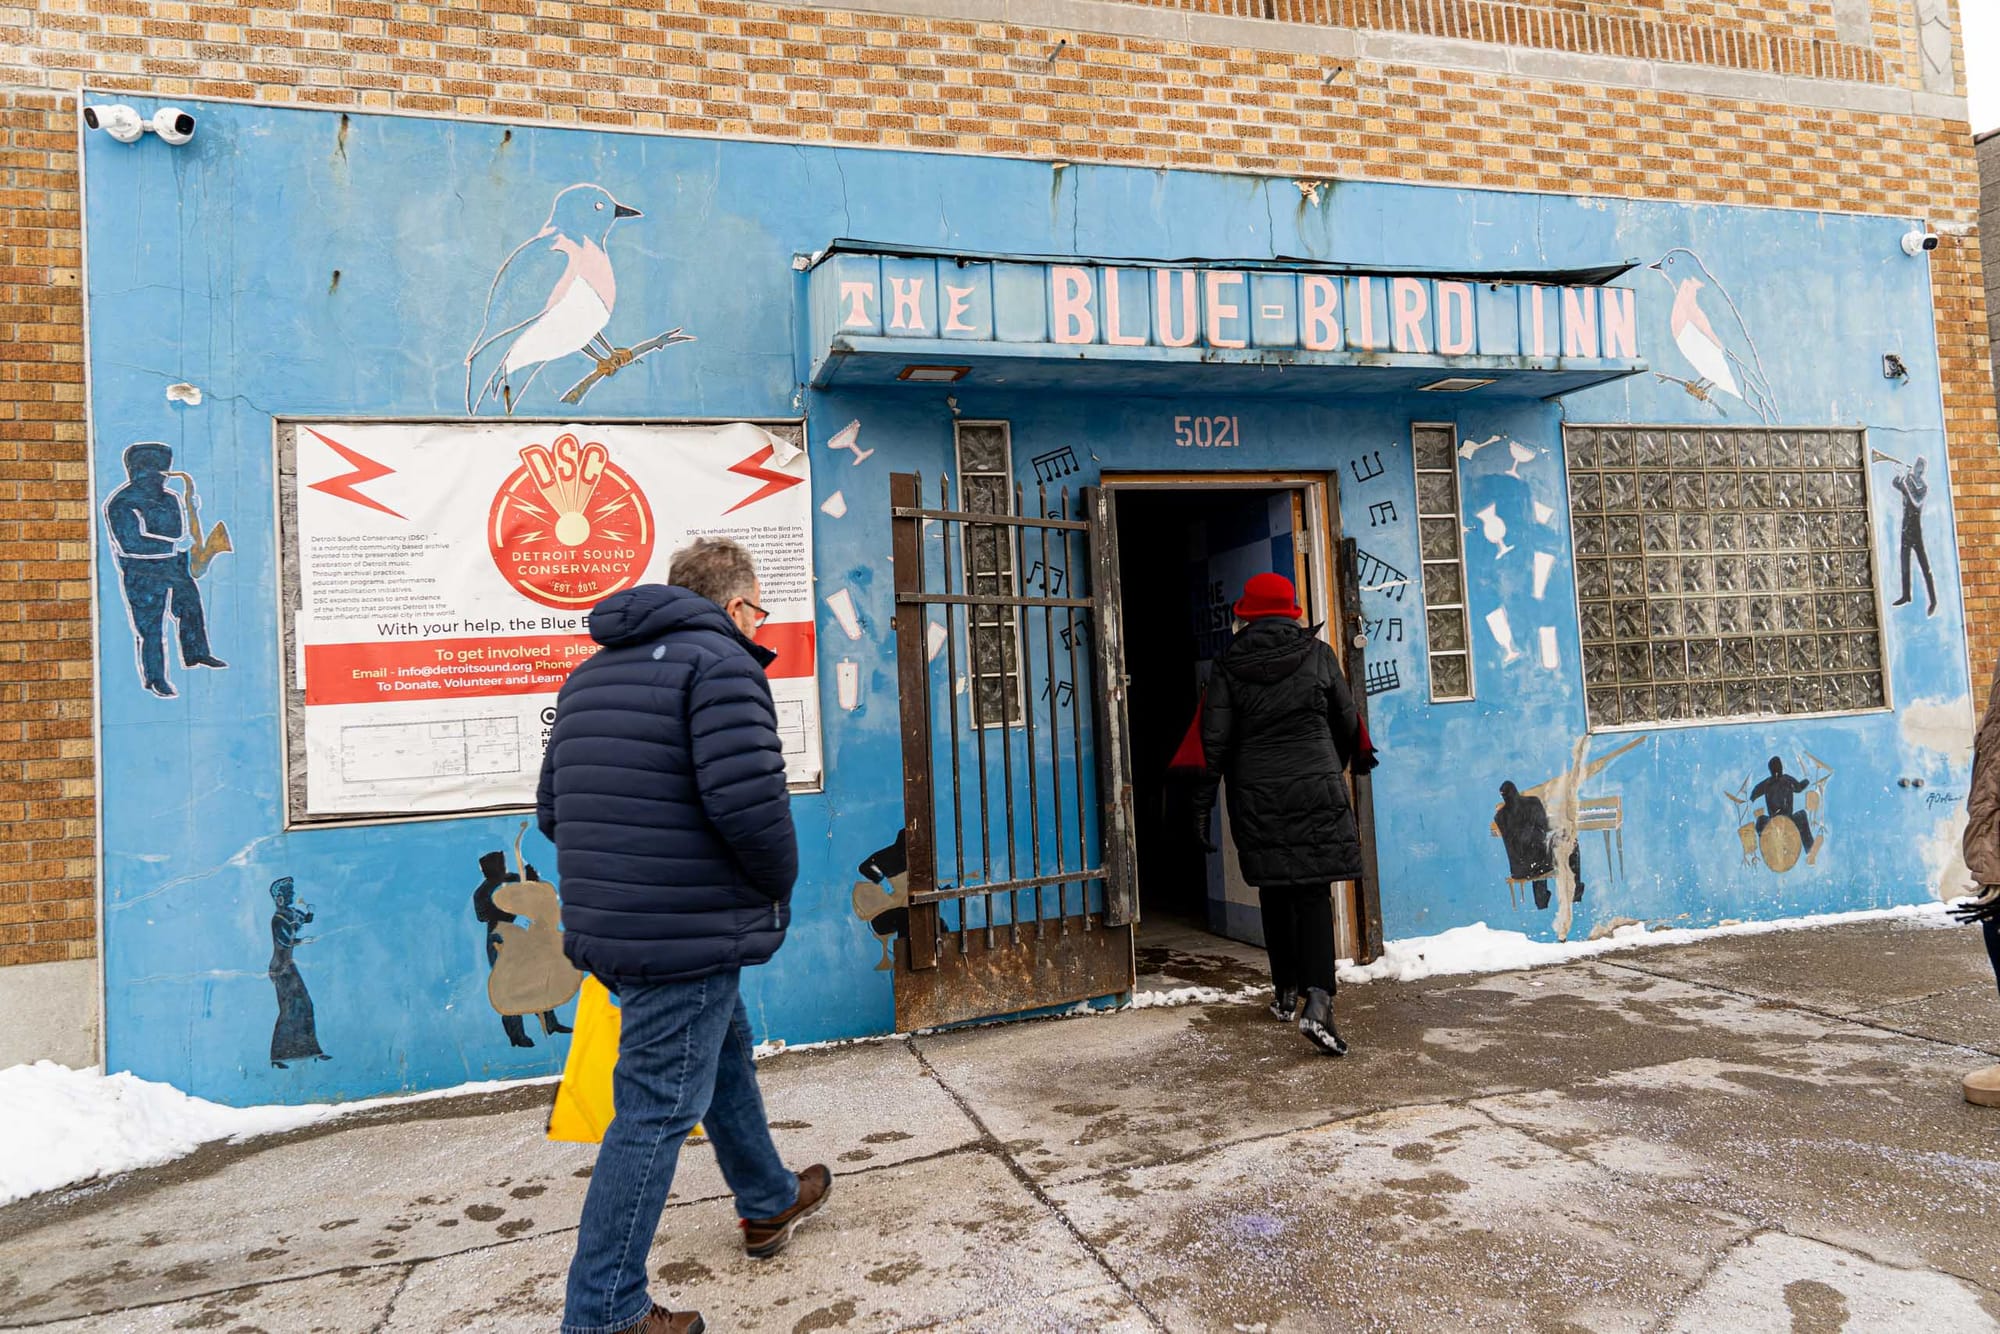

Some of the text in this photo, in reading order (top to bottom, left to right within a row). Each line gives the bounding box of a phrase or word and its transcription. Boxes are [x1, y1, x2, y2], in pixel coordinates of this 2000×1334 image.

[840, 277, 977, 331] THE
[1531, 284, 1636, 358] INN
[1174, 416, 1239, 447] 5021
[522, 436, 607, 489] DSC
[512, 548, 635, 562] DETROIT SOUND
[517, 562, 631, 576] CONSERVANCY
[553, 580, 598, 594] EST. 2012
[377, 622, 418, 636] With
[422, 620, 460, 637] your
[464, 618, 505, 636] help,
[510, 617, 536, 630] the
[541, 616, 577, 630] Blue
[435, 648, 455, 662] To
[457, 648, 484, 664] get
[487, 644, 550, 660] involved
[352, 668, 388, 680] Email
[398, 660, 532, 679] info@detroitsound.org
[535, 658, 573, 670] Phone
[376, 680, 391, 692] To
[394, 678, 442, 692] Donate,
[444, 676, 502, 690] Volunteer
[505, 674, 528, 685] and
[531, 672, 564, 684] Learn
